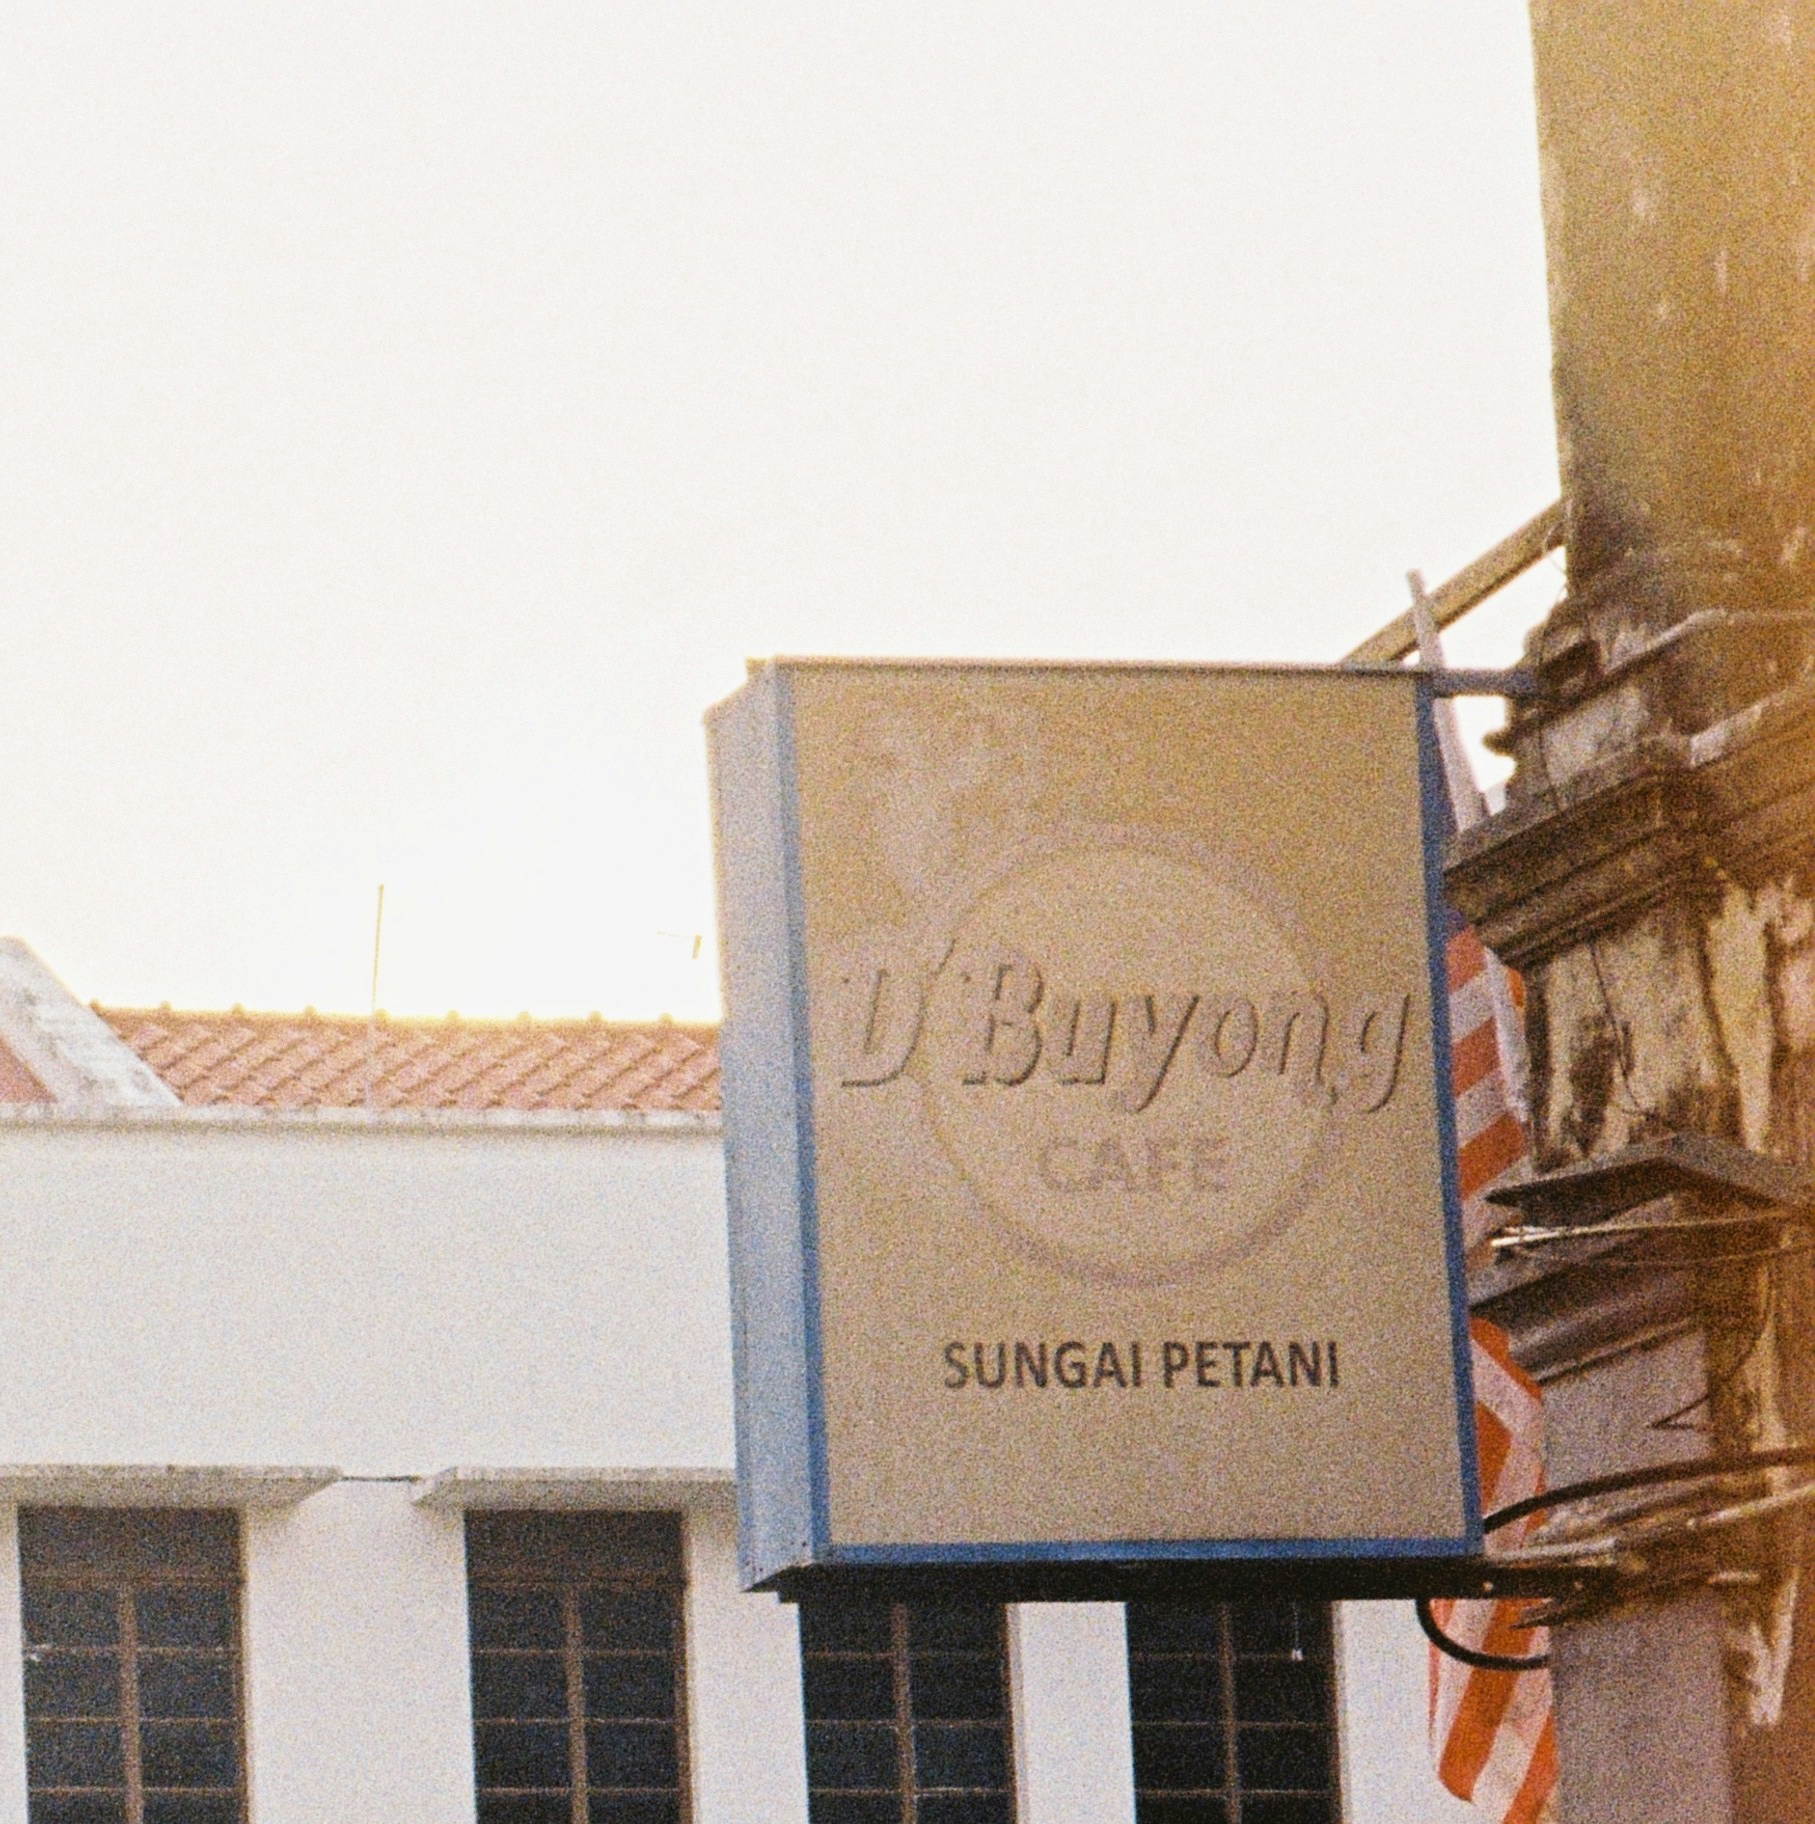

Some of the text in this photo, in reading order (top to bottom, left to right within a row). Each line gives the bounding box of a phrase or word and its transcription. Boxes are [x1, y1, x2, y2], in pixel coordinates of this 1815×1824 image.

[1039, 1136, 1229, 1194] CAFE
[943, 1340, 1341, 1389] SUNGAI PETANI
